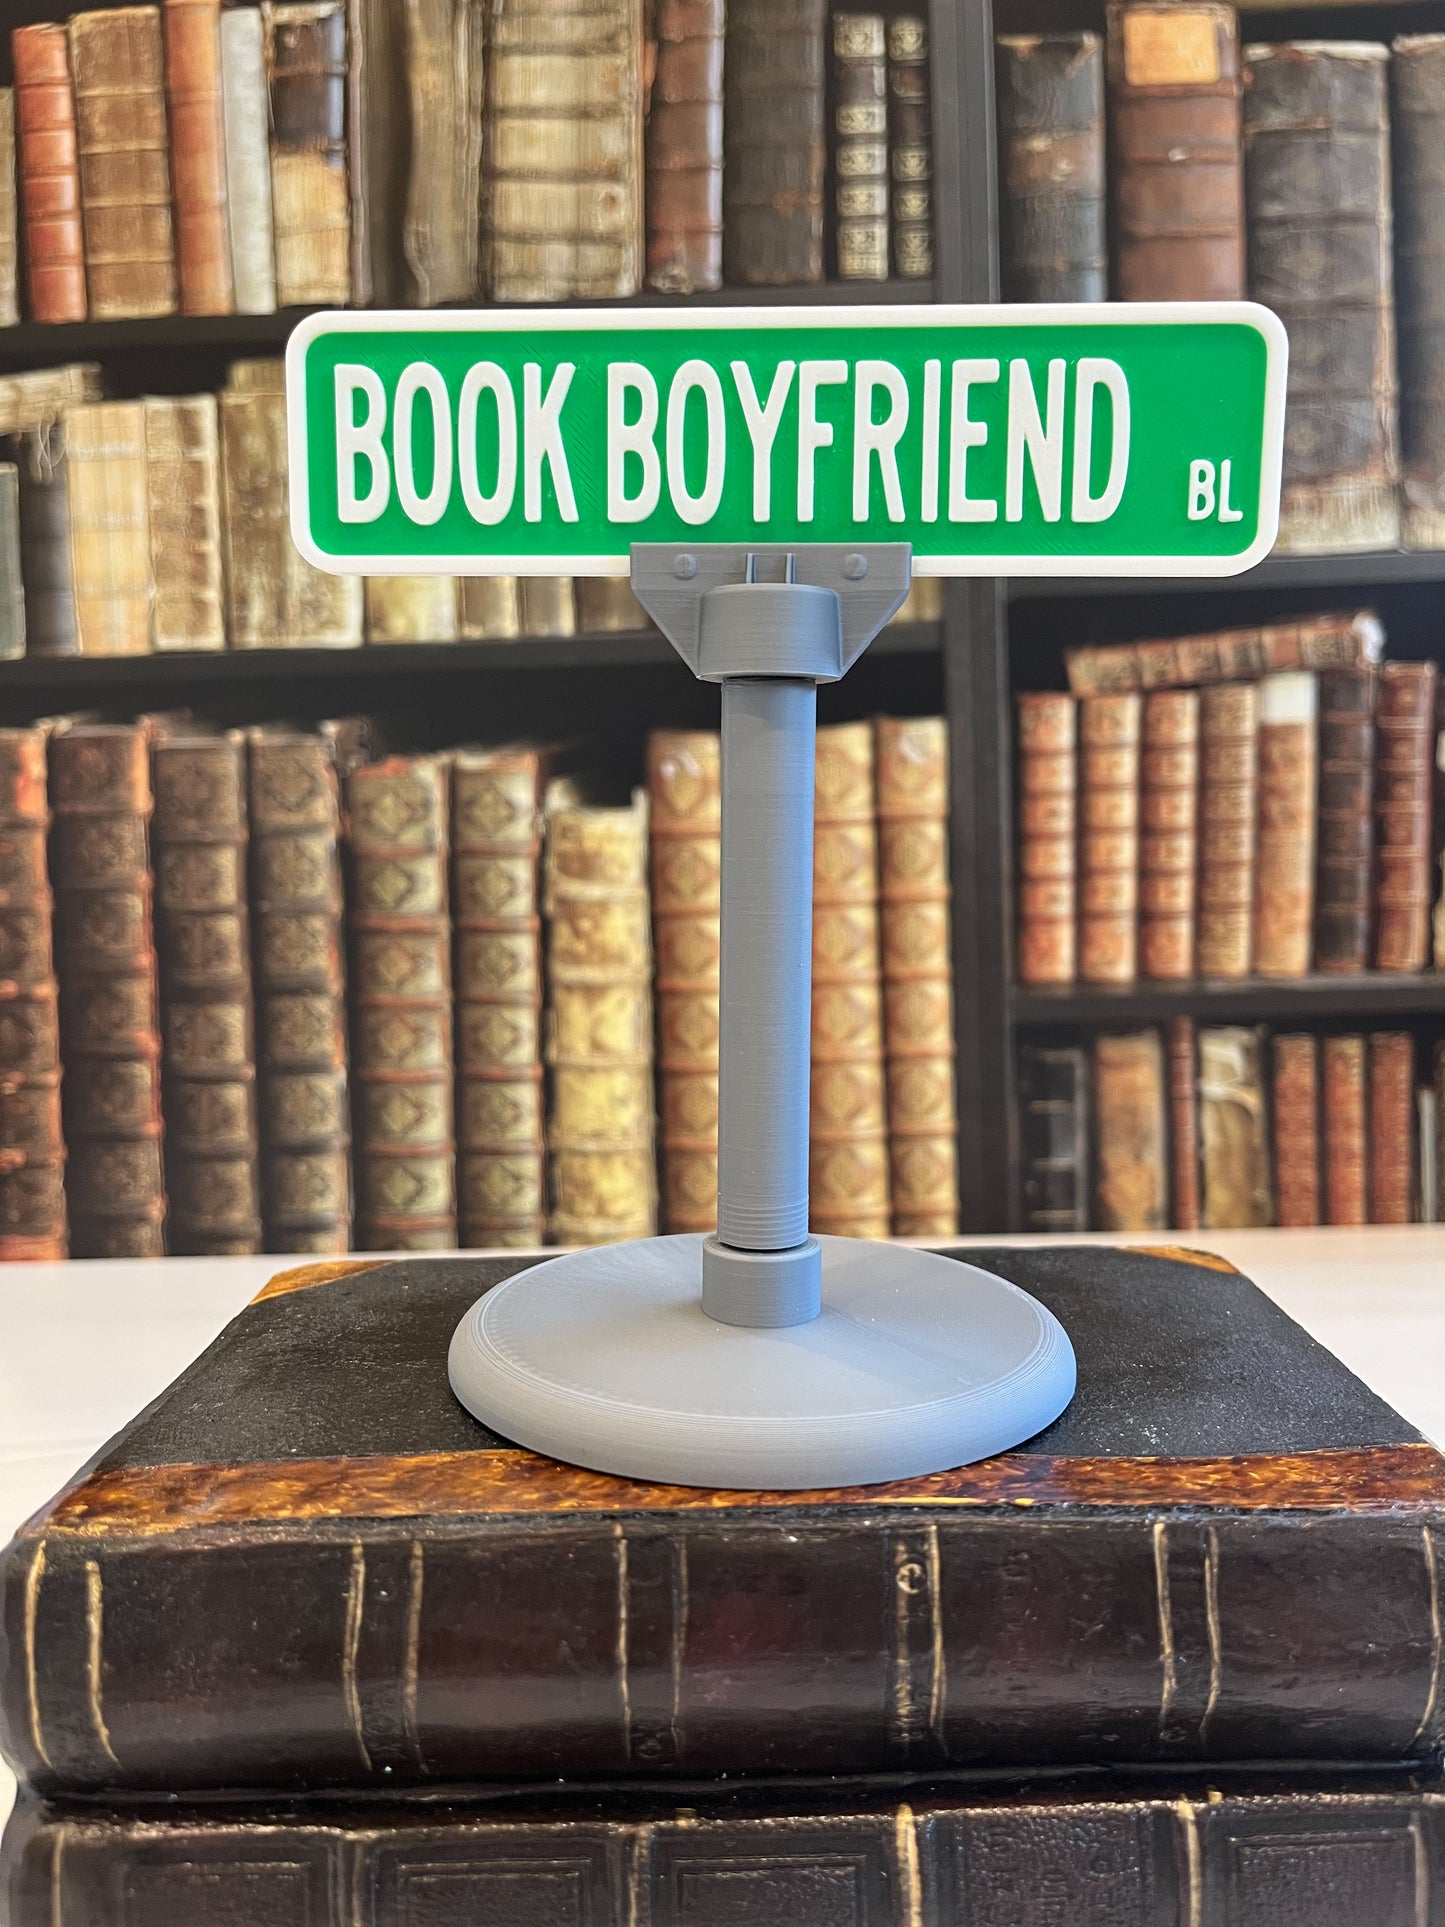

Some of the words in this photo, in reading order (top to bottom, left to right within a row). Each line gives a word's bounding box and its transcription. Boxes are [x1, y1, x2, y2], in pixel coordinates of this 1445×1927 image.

[333, 361, 580, 526] BOOK
[607, 358, 1132, 525] BOYFRIEND
[1187, 458, 1244, 524] BL
